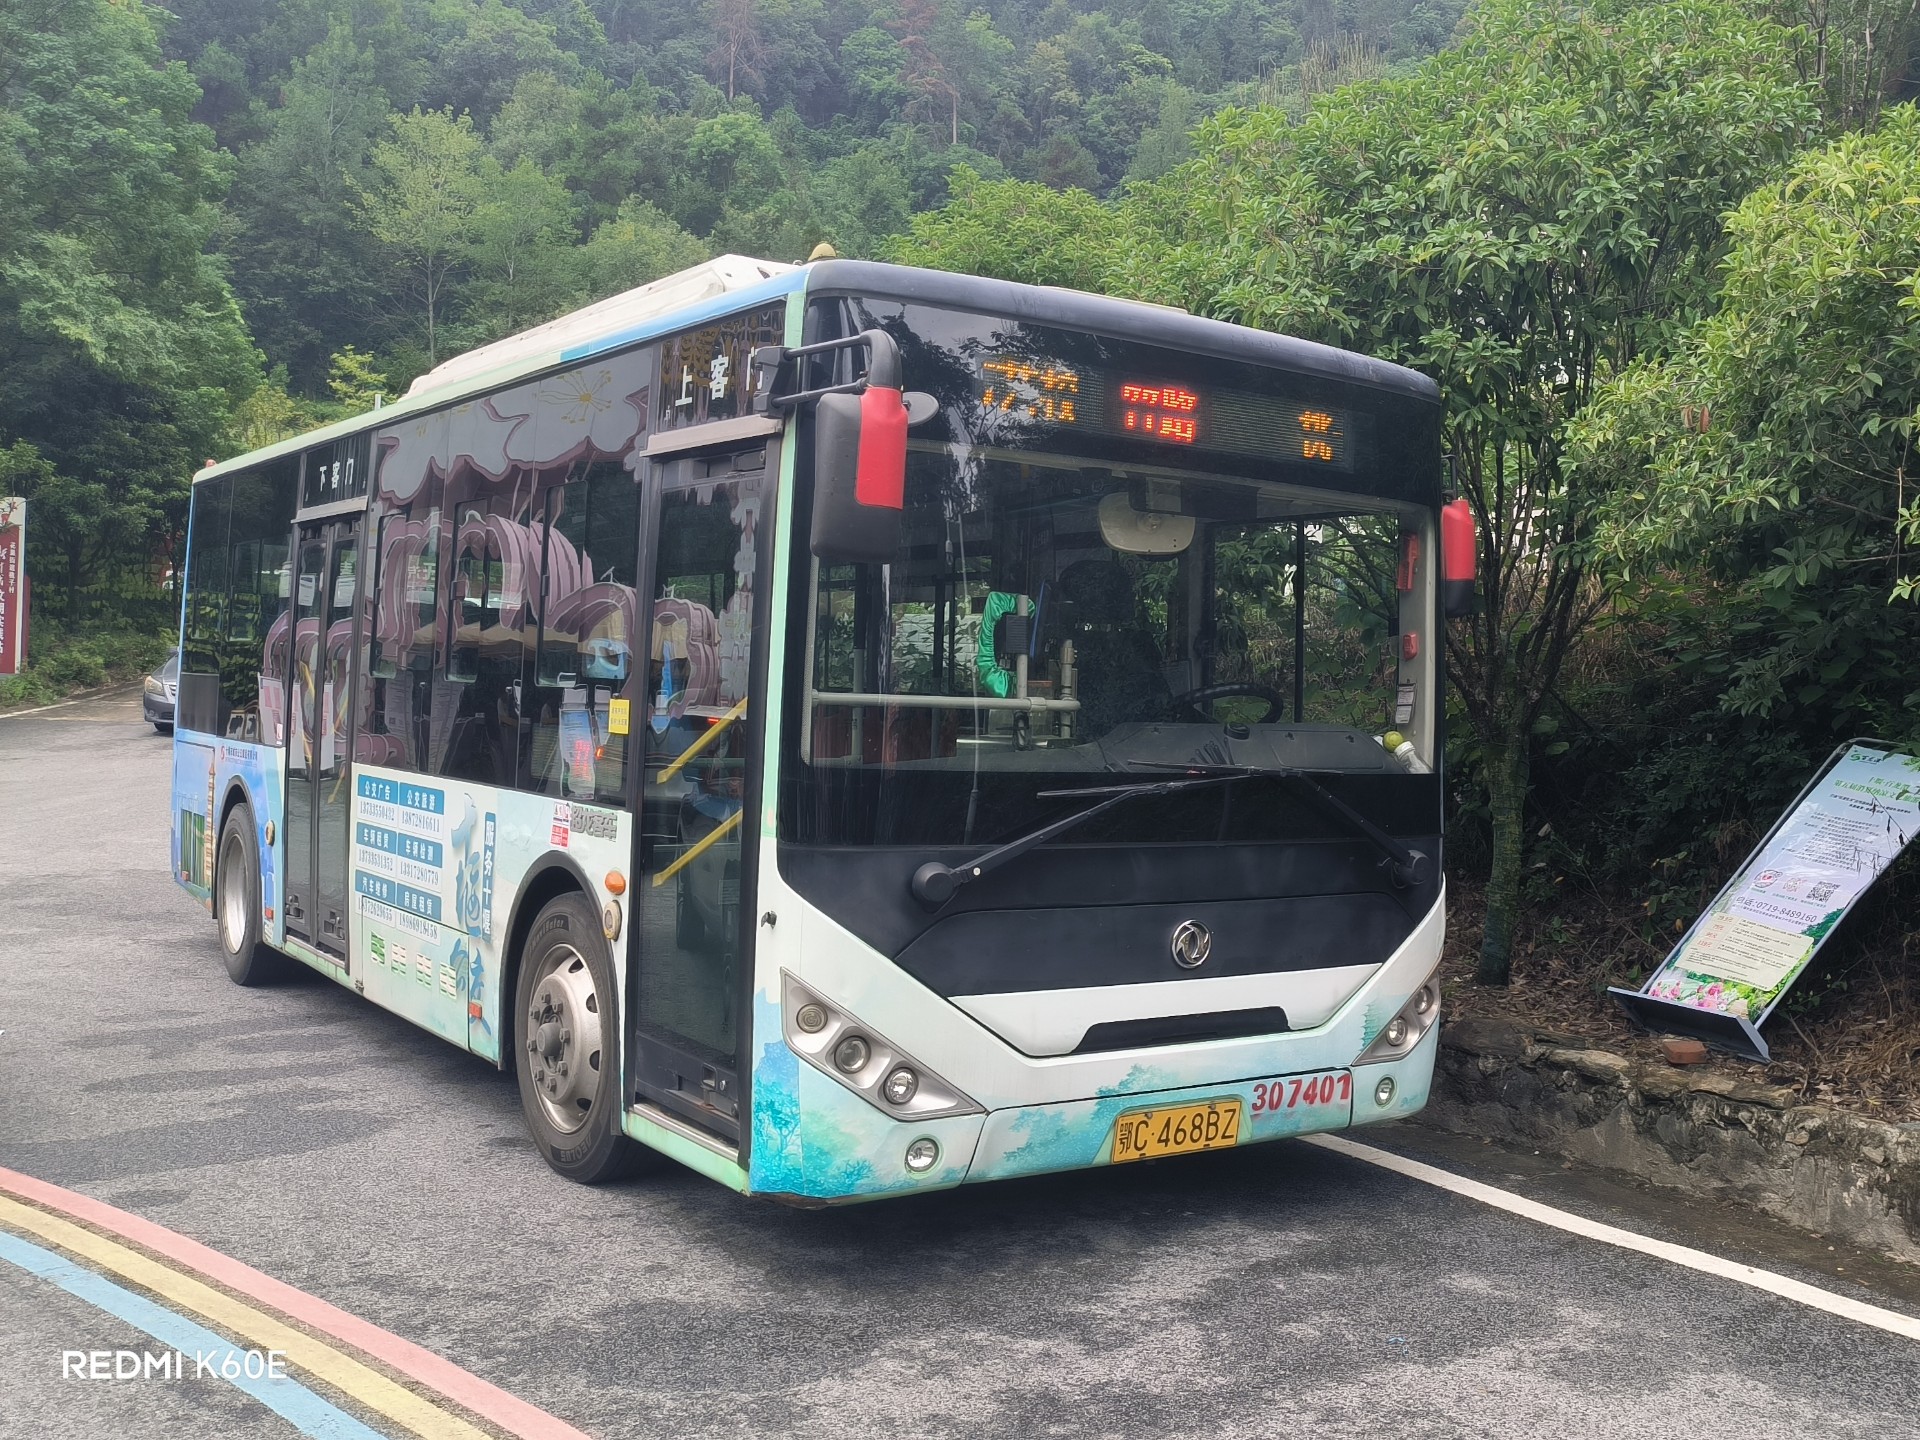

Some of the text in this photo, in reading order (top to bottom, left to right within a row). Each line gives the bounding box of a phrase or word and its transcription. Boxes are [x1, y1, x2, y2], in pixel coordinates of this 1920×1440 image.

[319, 458, 354, 492] 下客门
[365, 781, 391, 801] 公交广告
[407, 789, 435, 811] 公交旅游
[1252, 1072, 1351, 1112] 307401
